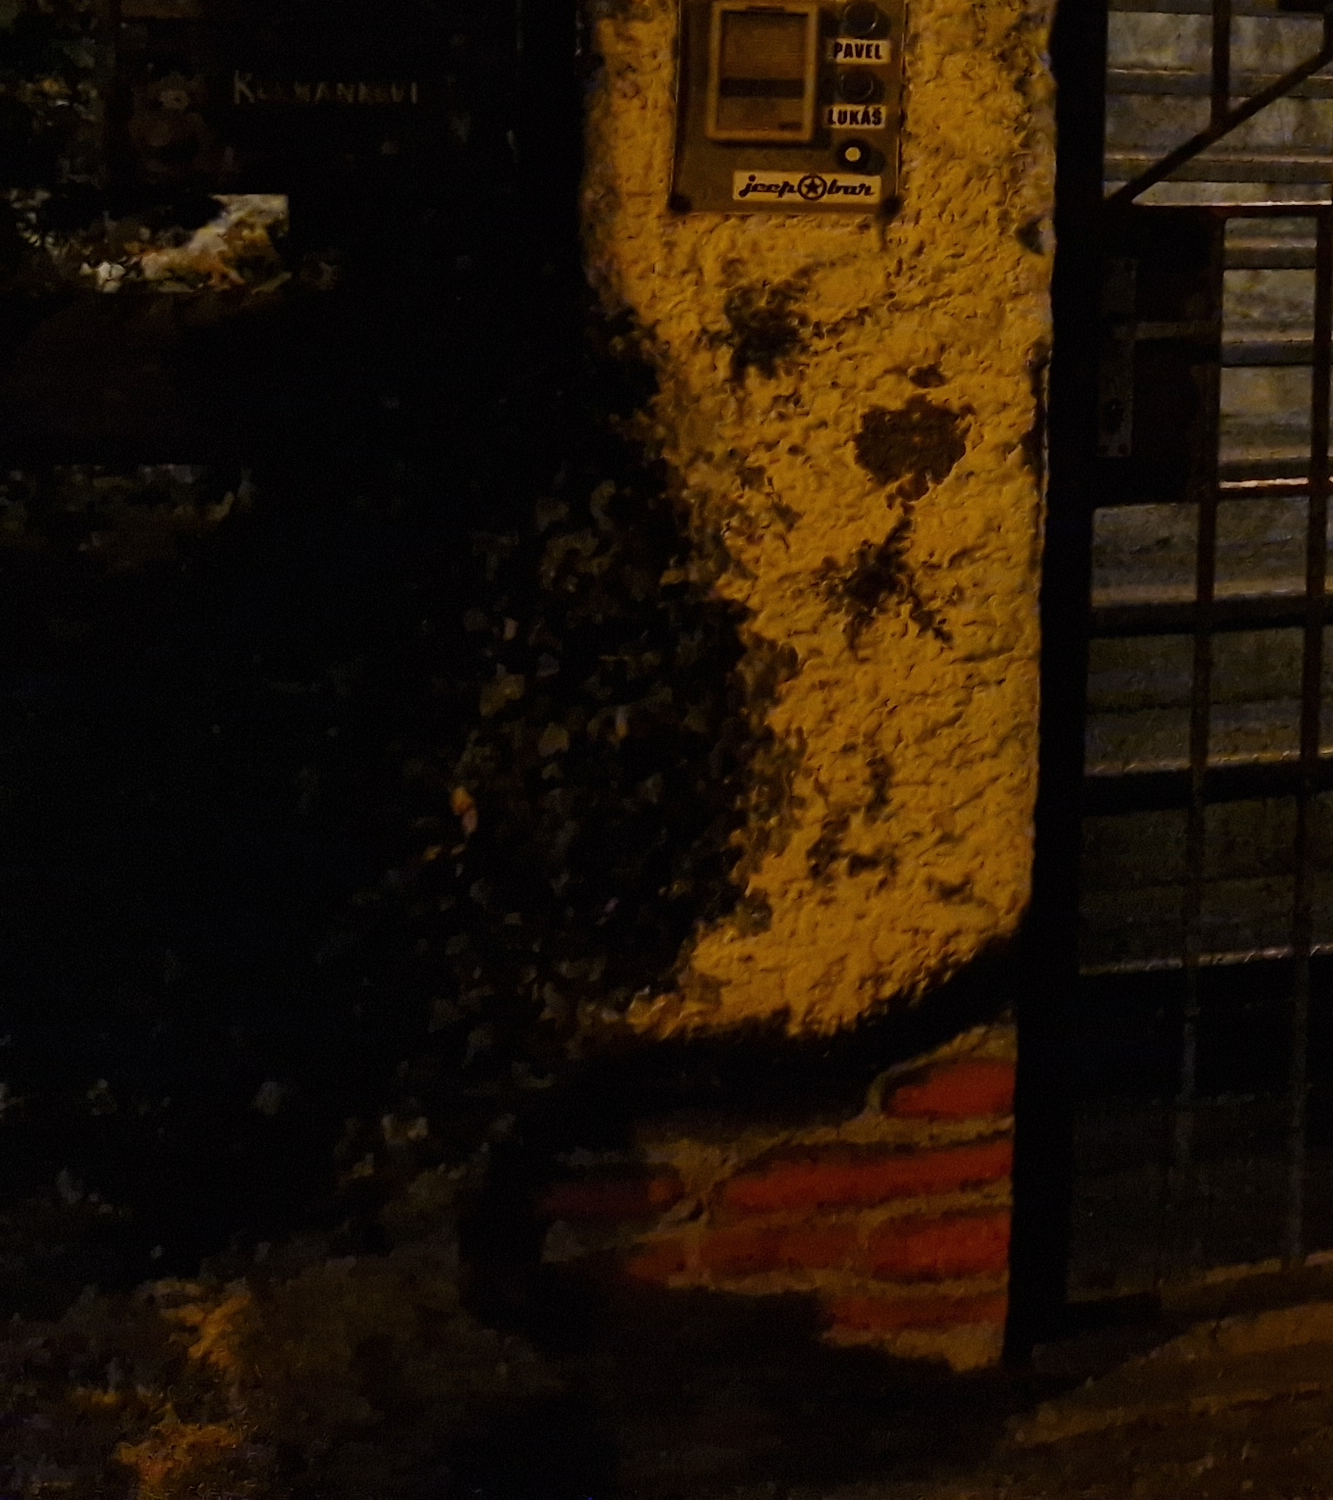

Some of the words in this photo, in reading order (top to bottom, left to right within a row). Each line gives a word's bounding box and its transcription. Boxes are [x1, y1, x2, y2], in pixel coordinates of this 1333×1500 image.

[833, 41, 884, 60] PAVEL
[826, 105, 884, 127] LUKÁŠ
[738, 173, 798, 198] jeep
[826, 178, 875, 197] bar
